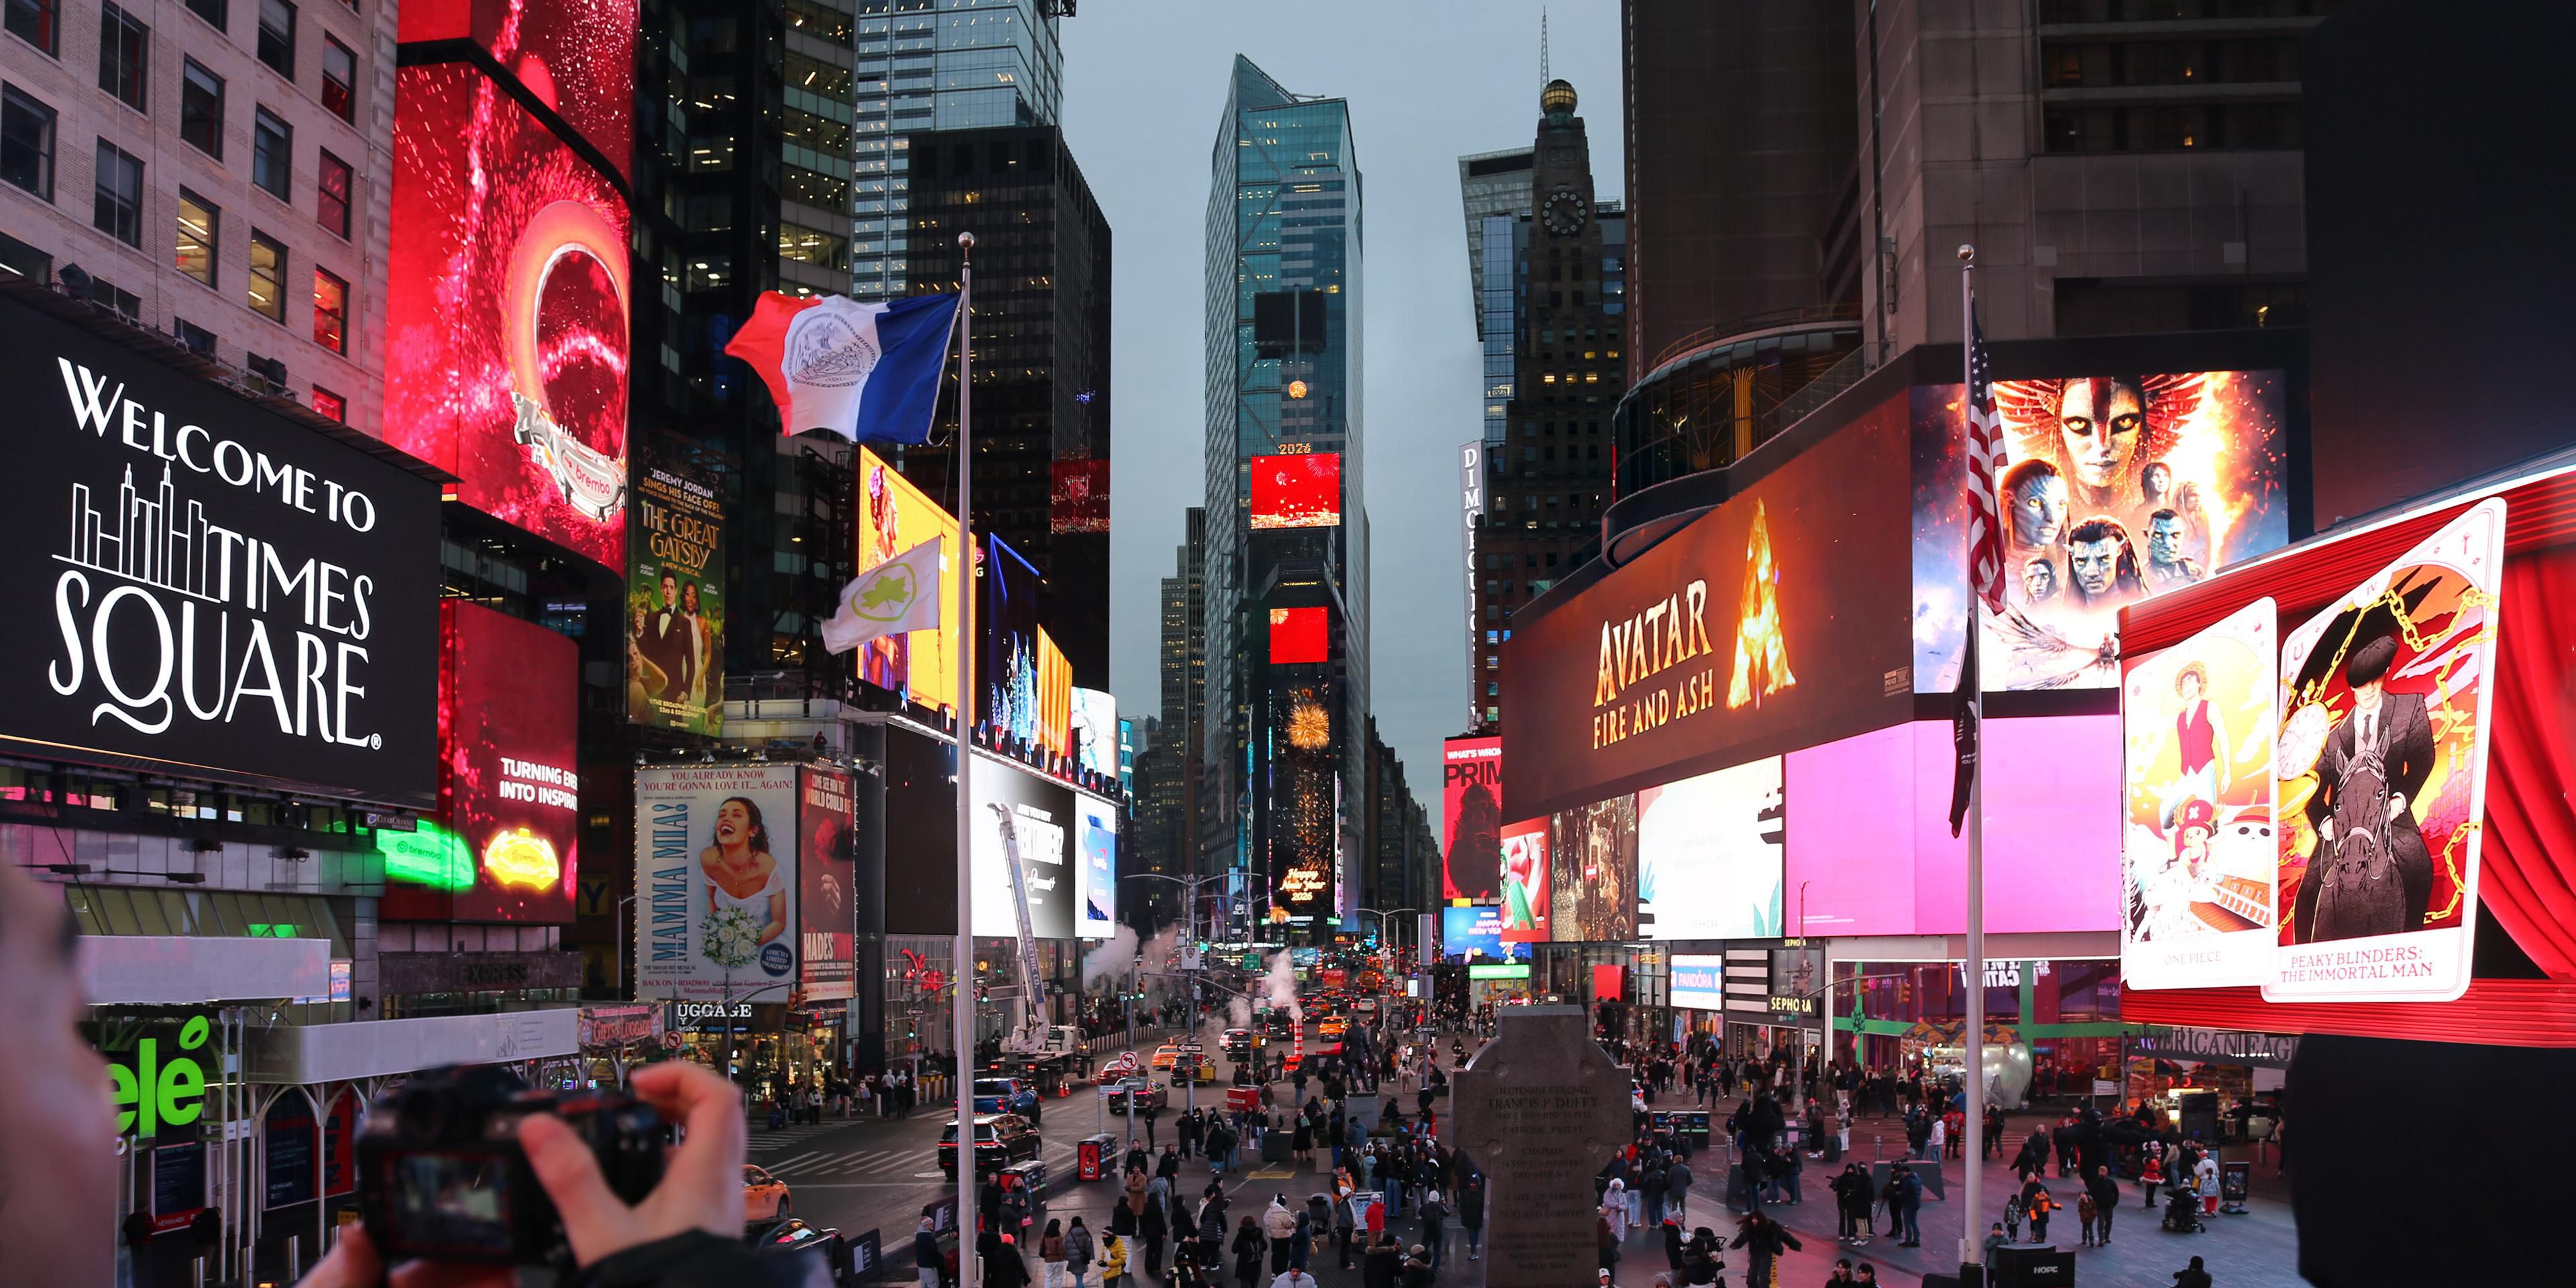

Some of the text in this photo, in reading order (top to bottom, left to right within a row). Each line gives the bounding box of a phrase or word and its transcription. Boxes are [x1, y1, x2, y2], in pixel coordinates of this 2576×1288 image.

[58, 356, 376, 533] WELCOME TO
[1279, 443, 1311, 455] 2026
[575, 464, 610, 494] brembo
[643, 477, 667, 493] SINGS
[669, 486, 681, 499] HIS
[683, 491, 702, 506] FACE
[703, 499, 720, 512] OFF!
[683, 481, 714, 499] JORDAN
[685, 501, 694, 510] BACK
[642, 502, 720, 549] THE GREAT
[650, 532, 711, 570] GATSBY
[666, 562, 679, 571] NEW
[679, 565, 702, 578] MUSICAL
[208, 525, 373, 640] TIMES
[1593, 579, 1713, 708] AVATAR
[1593, 668, 1714, 750] FIRE AND ASH
[1447, 749, 1477, 760] WHAT'S
[500, 757, 562, 786] TURNING
[671, 770, 766, 780] YOU ALREADY KNOW
[499, 780, 536, 803] INTO
[644, 780, 793, 791] YOU'RE GONNA LOVE IT... AGAIN!
[830, 778, 838, 793] HOW
[804, 787, 852, 815] WORLD COULD BE
[1029, 806, 1040, 819] YOU
[652, 803, 688, 860] MIA!
[408, 844, 441, 860] brembo
[518, 852, 537, 863] brembo
[1287, 868, 1319, 881] Happy
[1279, 878, 1327, 892] New Year
[580, 882, 608, 913] Y
[1291, 892, 1313, 902] 2026
[652, 865, 688, 962] MAMMA
[1785, 939, 1806, 947] SEPHOA
[765, 955, 788, 964] LIMITED
[766, 949, 789, 959] STRICTLY
[1025, 933, 1038, 972] ELECTRIC
[2164, 951, 2223, 965] ONE PIECE
[2290, 946, 2424, 969] PEAKY BLINDERS:
[761, 960, 791, 972] ENGAGEMENT
[2280, 961, 2434, 983] THE IMMORTAL MAN
[620, 1017, 651, 1039] LUGGAGE
[2135, 1026, 2239, 1056] AMERICAN
[1548, 1086, 1589, 1095] COLONEL
[1488, 1098, 1540, 1109] FRANCIS
[1555, 1096, 1599, 1108] DUFFY
[1494, 1112, 1511, 1120] MAY
[1502, 1125, 1583, 1134] CATHOLIC PRIEST
[1521, 1147, 1565, 1155] CHAPLAIN
[1545, 1209, 1587, 1218] COUNTRY
[2033, 1266, 2058, 1275] HOPE
